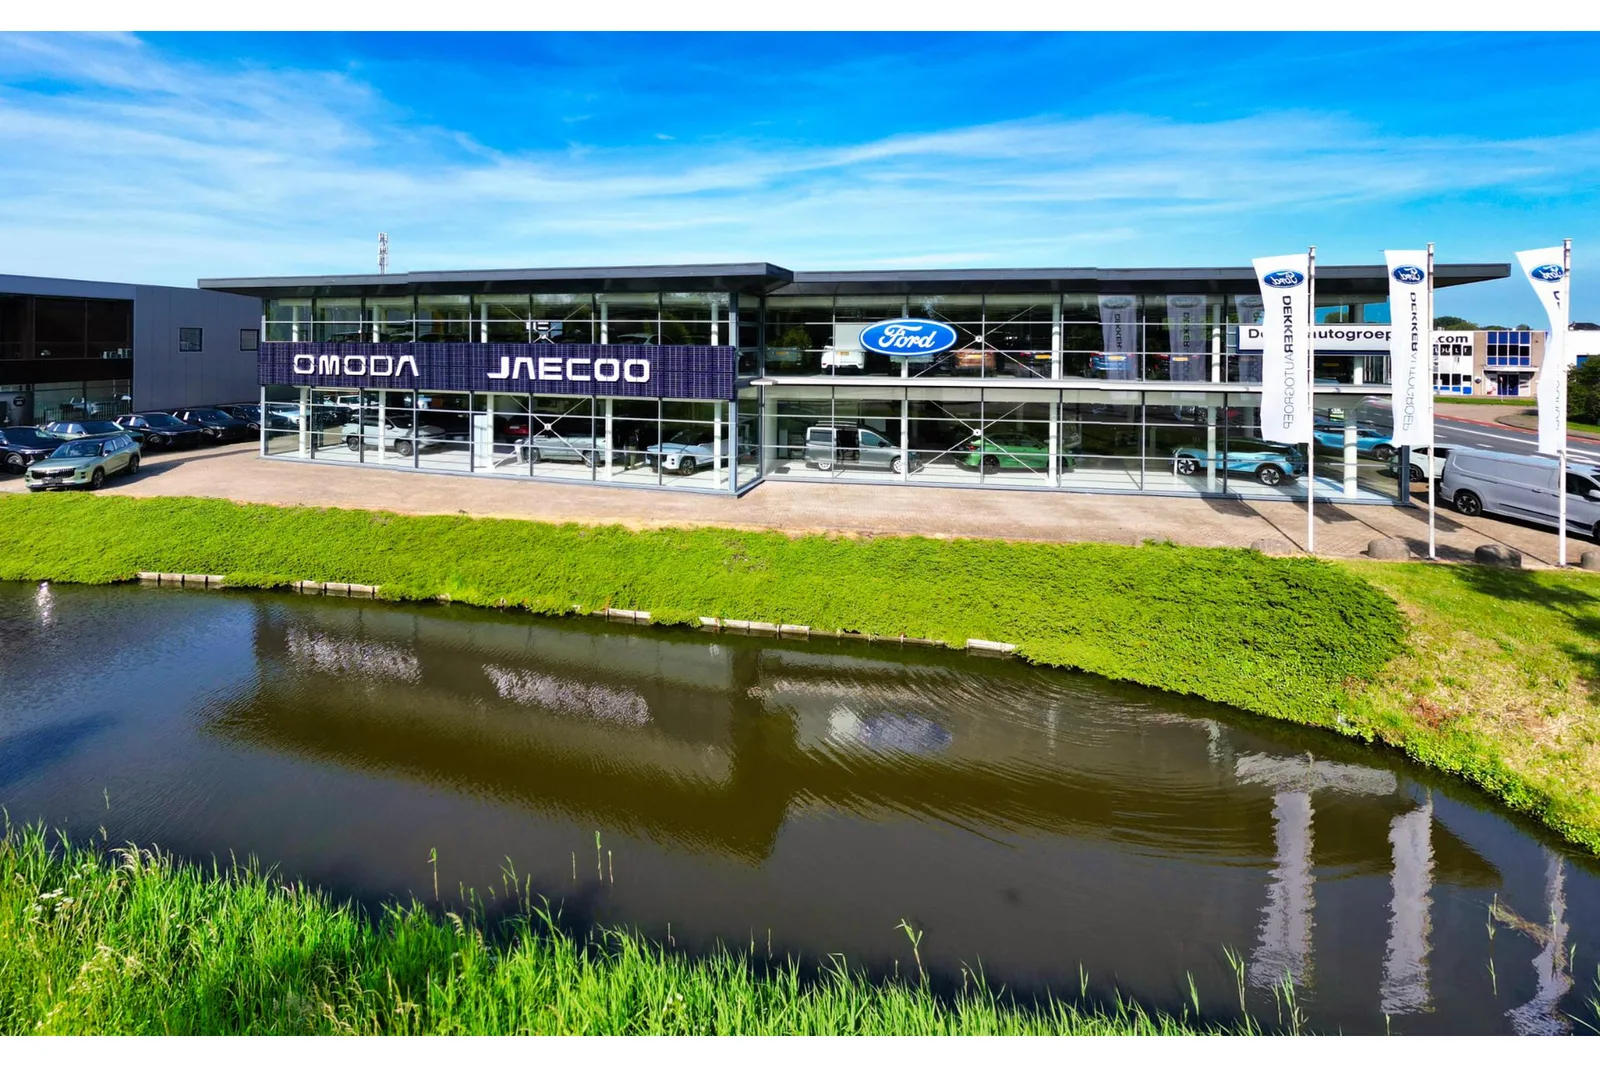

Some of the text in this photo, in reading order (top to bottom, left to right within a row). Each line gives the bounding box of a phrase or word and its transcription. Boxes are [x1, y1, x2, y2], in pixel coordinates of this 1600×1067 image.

[878, 324, 938, 348] Ford
[293, 353, 651, 383] OMODA JAECOO
